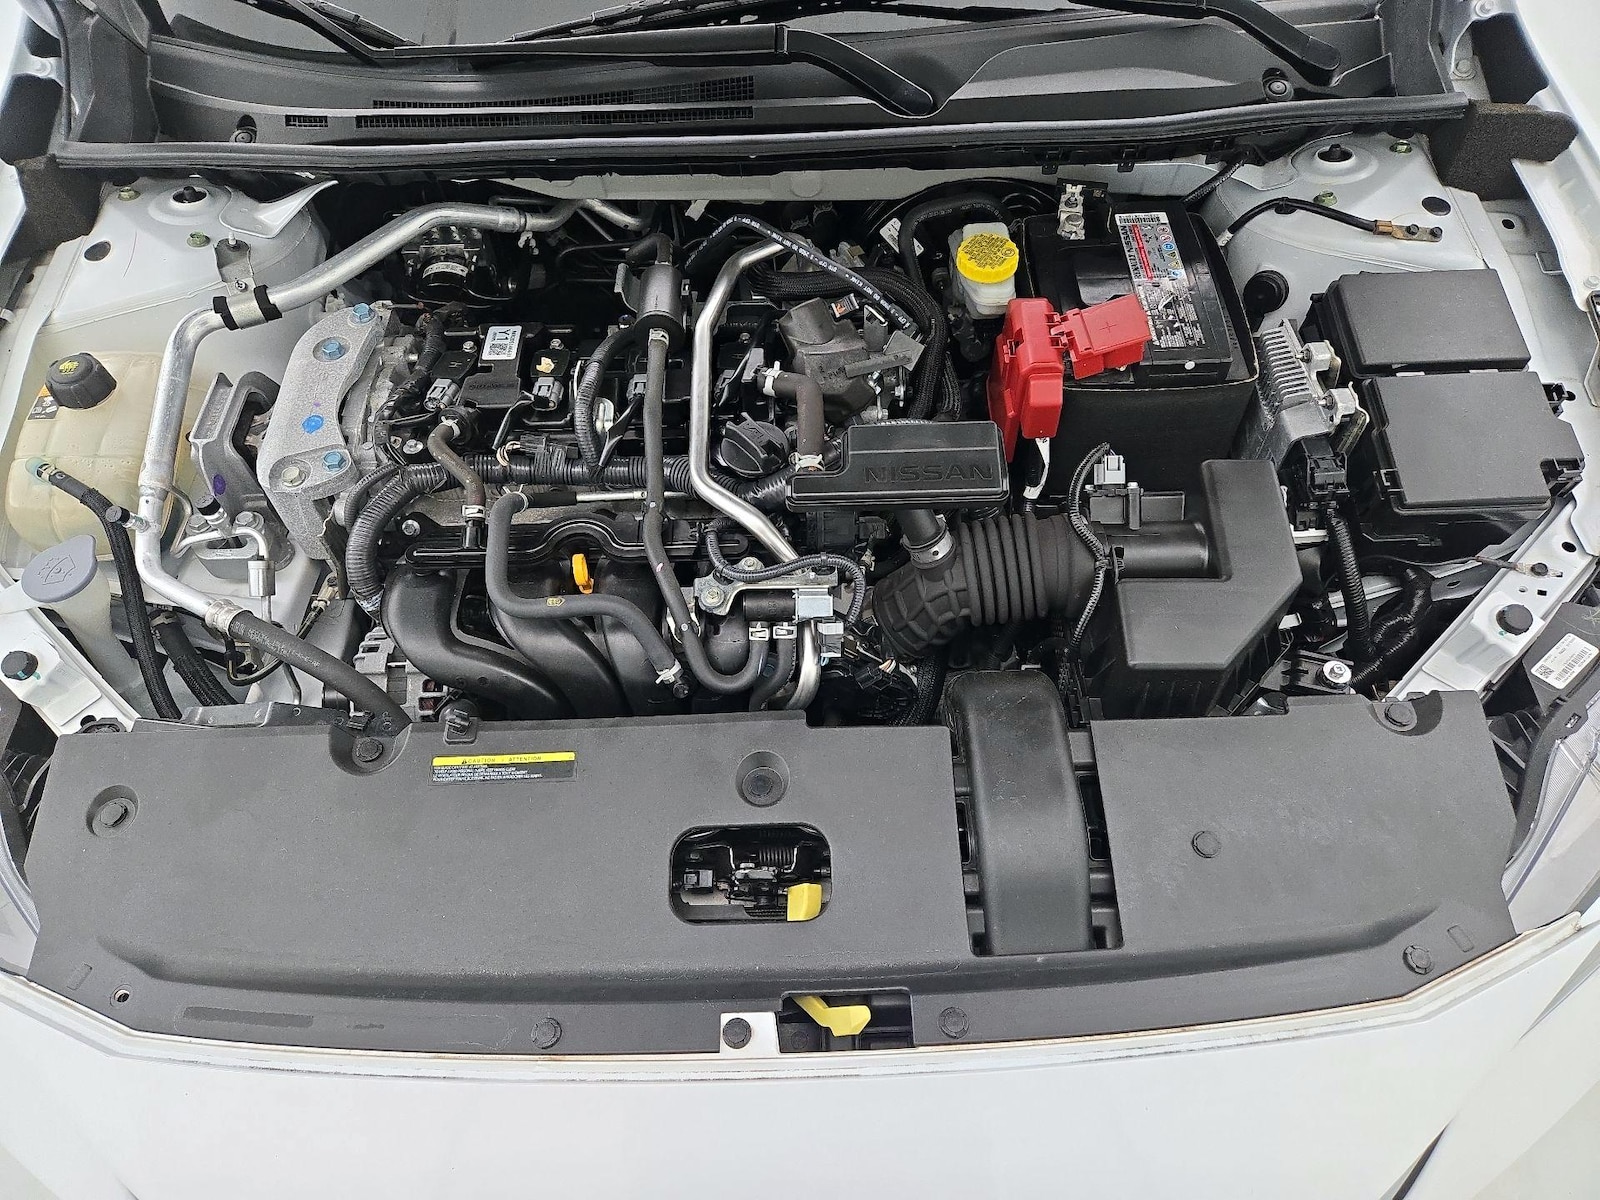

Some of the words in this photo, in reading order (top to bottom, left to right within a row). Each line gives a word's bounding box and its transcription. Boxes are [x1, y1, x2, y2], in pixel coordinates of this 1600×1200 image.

[1119, 224, 1133, 253] NISSAN
[497, 329, 511, 340] Y1
[864, 464, 993, 483] NISSAN
